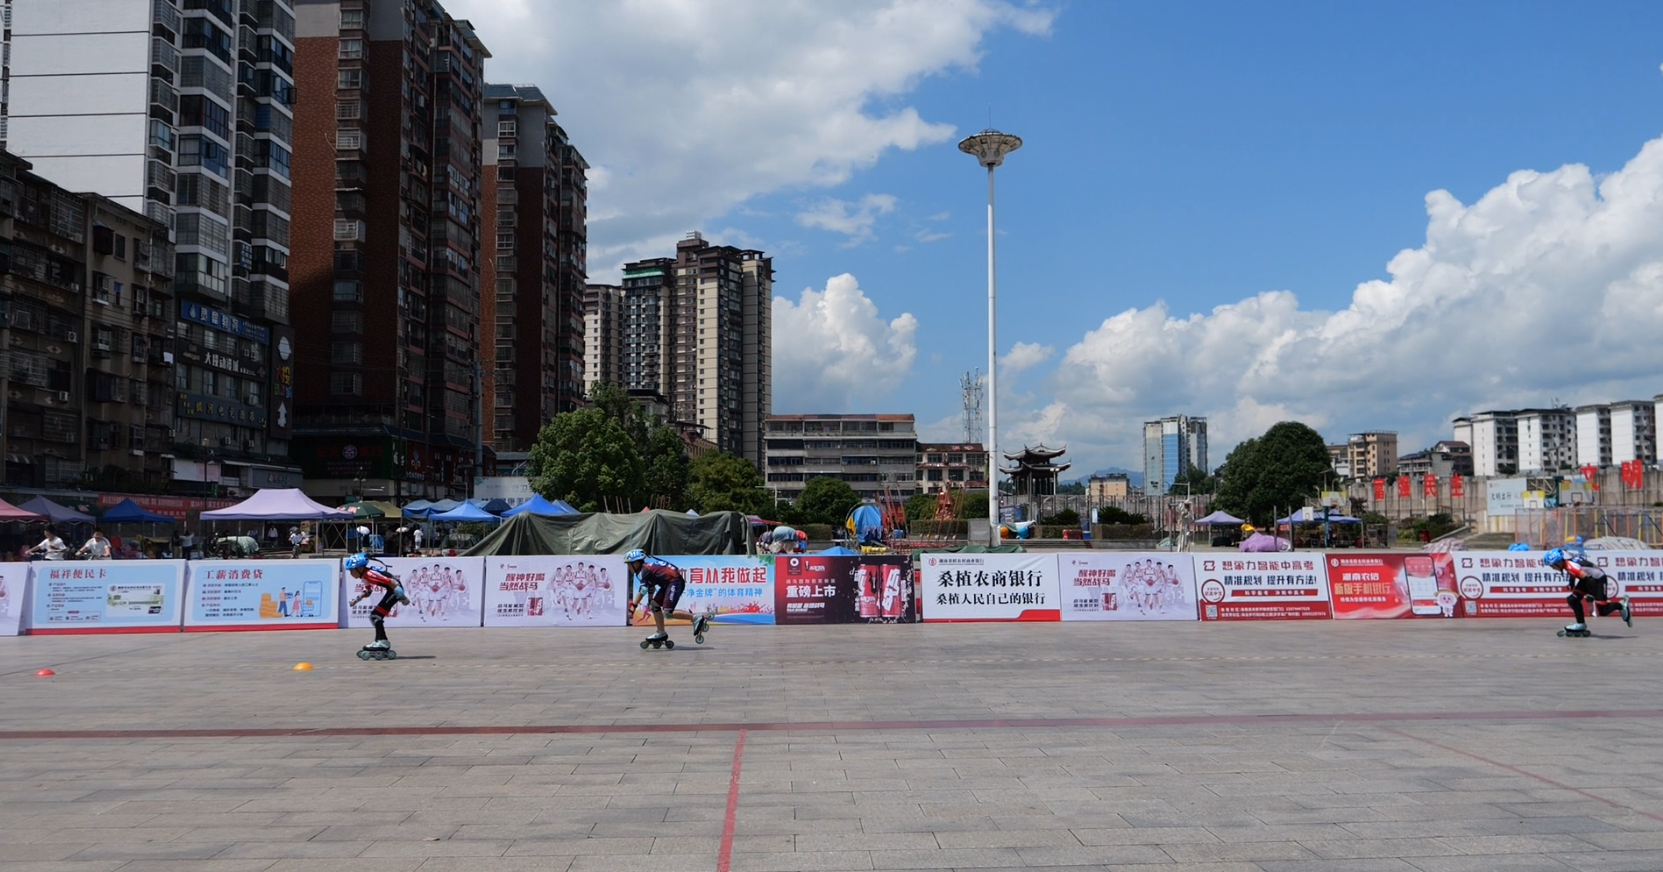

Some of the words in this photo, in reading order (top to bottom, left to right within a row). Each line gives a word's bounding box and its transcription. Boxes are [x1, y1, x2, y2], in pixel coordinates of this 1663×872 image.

[1222, 560, 1314, 571] 想象力智能中高考
[50, 568, 107, 580] 福祥便民卡
[204, 568, 263, 580] 工薪消费贷
[938, 570, 1042, 588] 桑植农商银行
[1224, 575, 1262, 585] 精准规划
[1482, 572, 1520, 582] 精准规划
[1617, 571, 1655, 581] 精准规划
[786, 585, 836, 598] 重磅上市
[1334, 583, 1391, 595] 新版手机银行
[936, 592, 1045, 605] 桑植人民自己的银行
